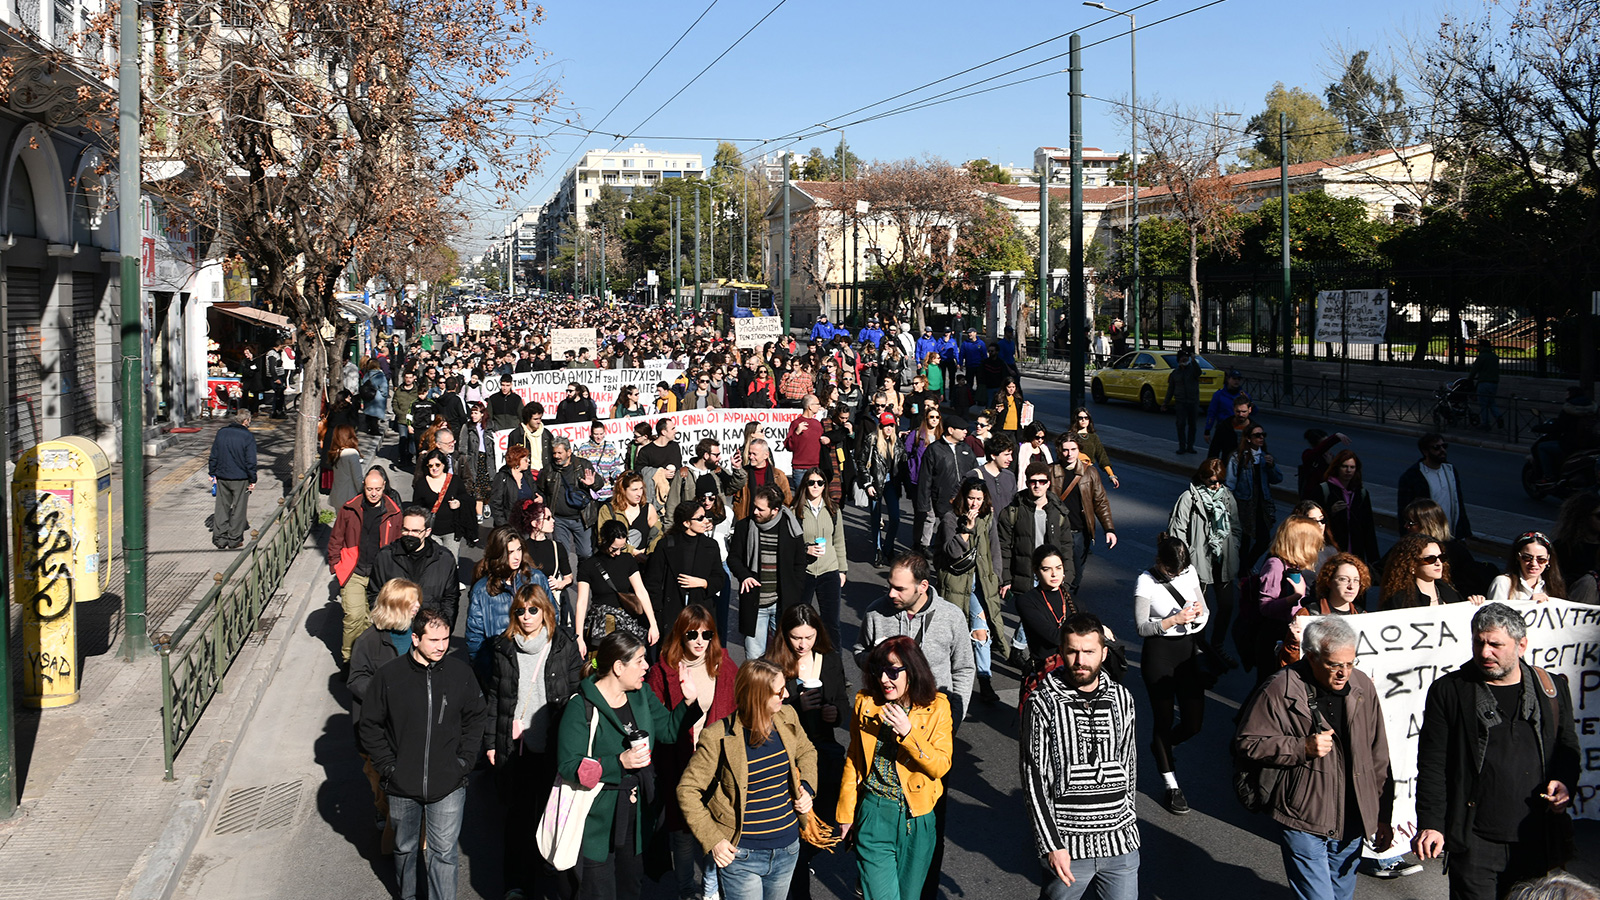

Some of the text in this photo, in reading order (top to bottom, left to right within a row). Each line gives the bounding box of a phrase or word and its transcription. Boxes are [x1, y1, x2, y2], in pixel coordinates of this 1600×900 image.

[739, 317, 755, 326] ΟΧΙ
[530, 370, 600, 385] ΥΠΟΒΑΘΜΙΣΗ
[603, 375, 618, 383] ΤΩΝ
[621, 369, 662, 382] ΠΤΥΧΙΩΝ
[682, 413, 704, 426] ΕΙΝΑΙ
[707, 412, 719, 423] ΟΙ
[723, 412, 769, 423] ΑΥΡΙΑΝΟΙ
